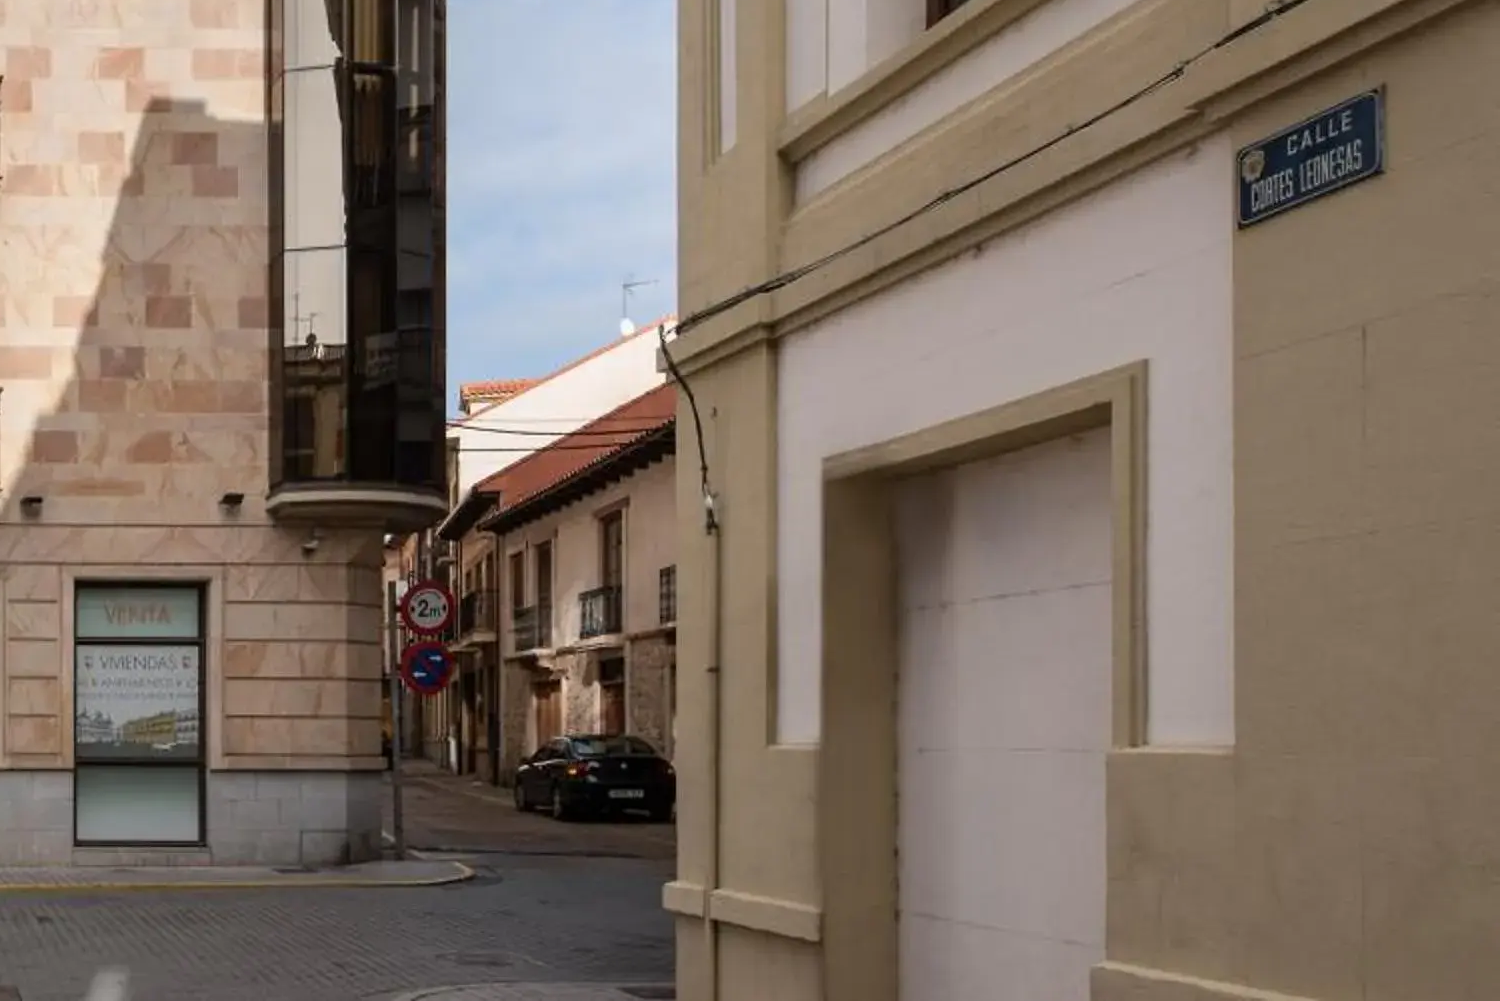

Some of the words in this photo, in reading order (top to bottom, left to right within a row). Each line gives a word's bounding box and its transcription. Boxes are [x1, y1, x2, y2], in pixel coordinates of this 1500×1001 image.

[1286, 109, 1353, 156] CALLE
[1250, 167, 1294, 213] CORTES
[1299, 138, 1363, 193] LEONESAS
[103, 602, 172, 626] VENTA
[99, 654, 178, 672] VIVIENDAS
